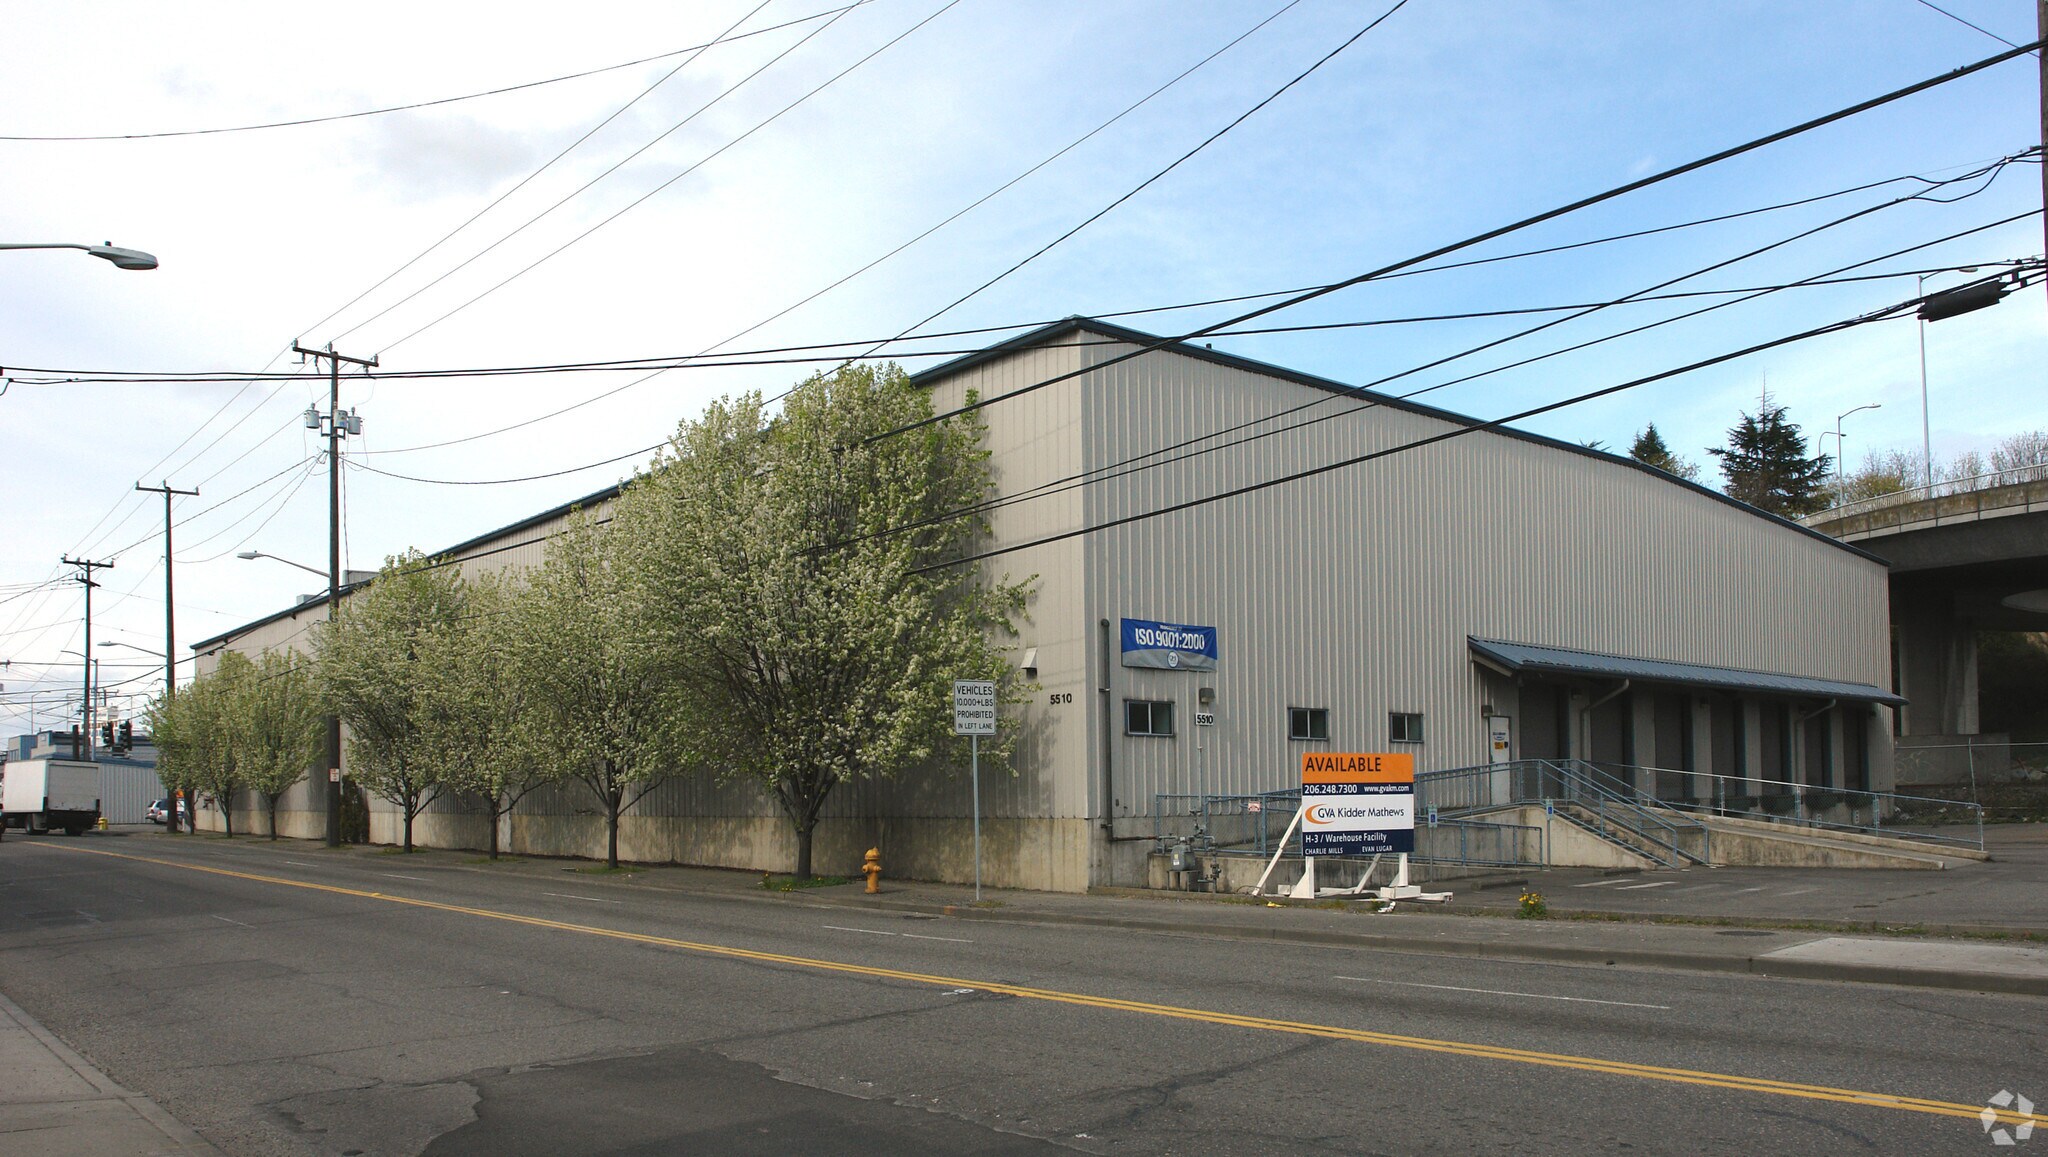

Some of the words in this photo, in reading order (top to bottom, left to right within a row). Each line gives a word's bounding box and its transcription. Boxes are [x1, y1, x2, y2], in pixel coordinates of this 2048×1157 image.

[1135, 628, 1154, 646] ISO
[1156, 631, 1205, 650] 9001:2000
[957, 686, 993, 695] VEHICLES
[1050, 693, 1072, 705] 5510
[957, 711, 993, 719] PROHIBITED
[1196, 714, 1213, 724] 5510
[1305, 757, 1381, 772] AVAILABLE
[1304, 785, 1358, 794] 206.248.7300
[1364, 784, 1410, 794] www.gvakm.com
[1317, 808, 1336, 818] GVA
[1337, 807, 1366, 818] Kidder
[1367, 807, 1405, 817] Mathews
[1305, 834, 1319, 843] H-3
[1325, 832, 1362, 842] Warehouse
[1363, 831, 1387, 843] Facility
[1361, 845, 1375, 853] EVAN
